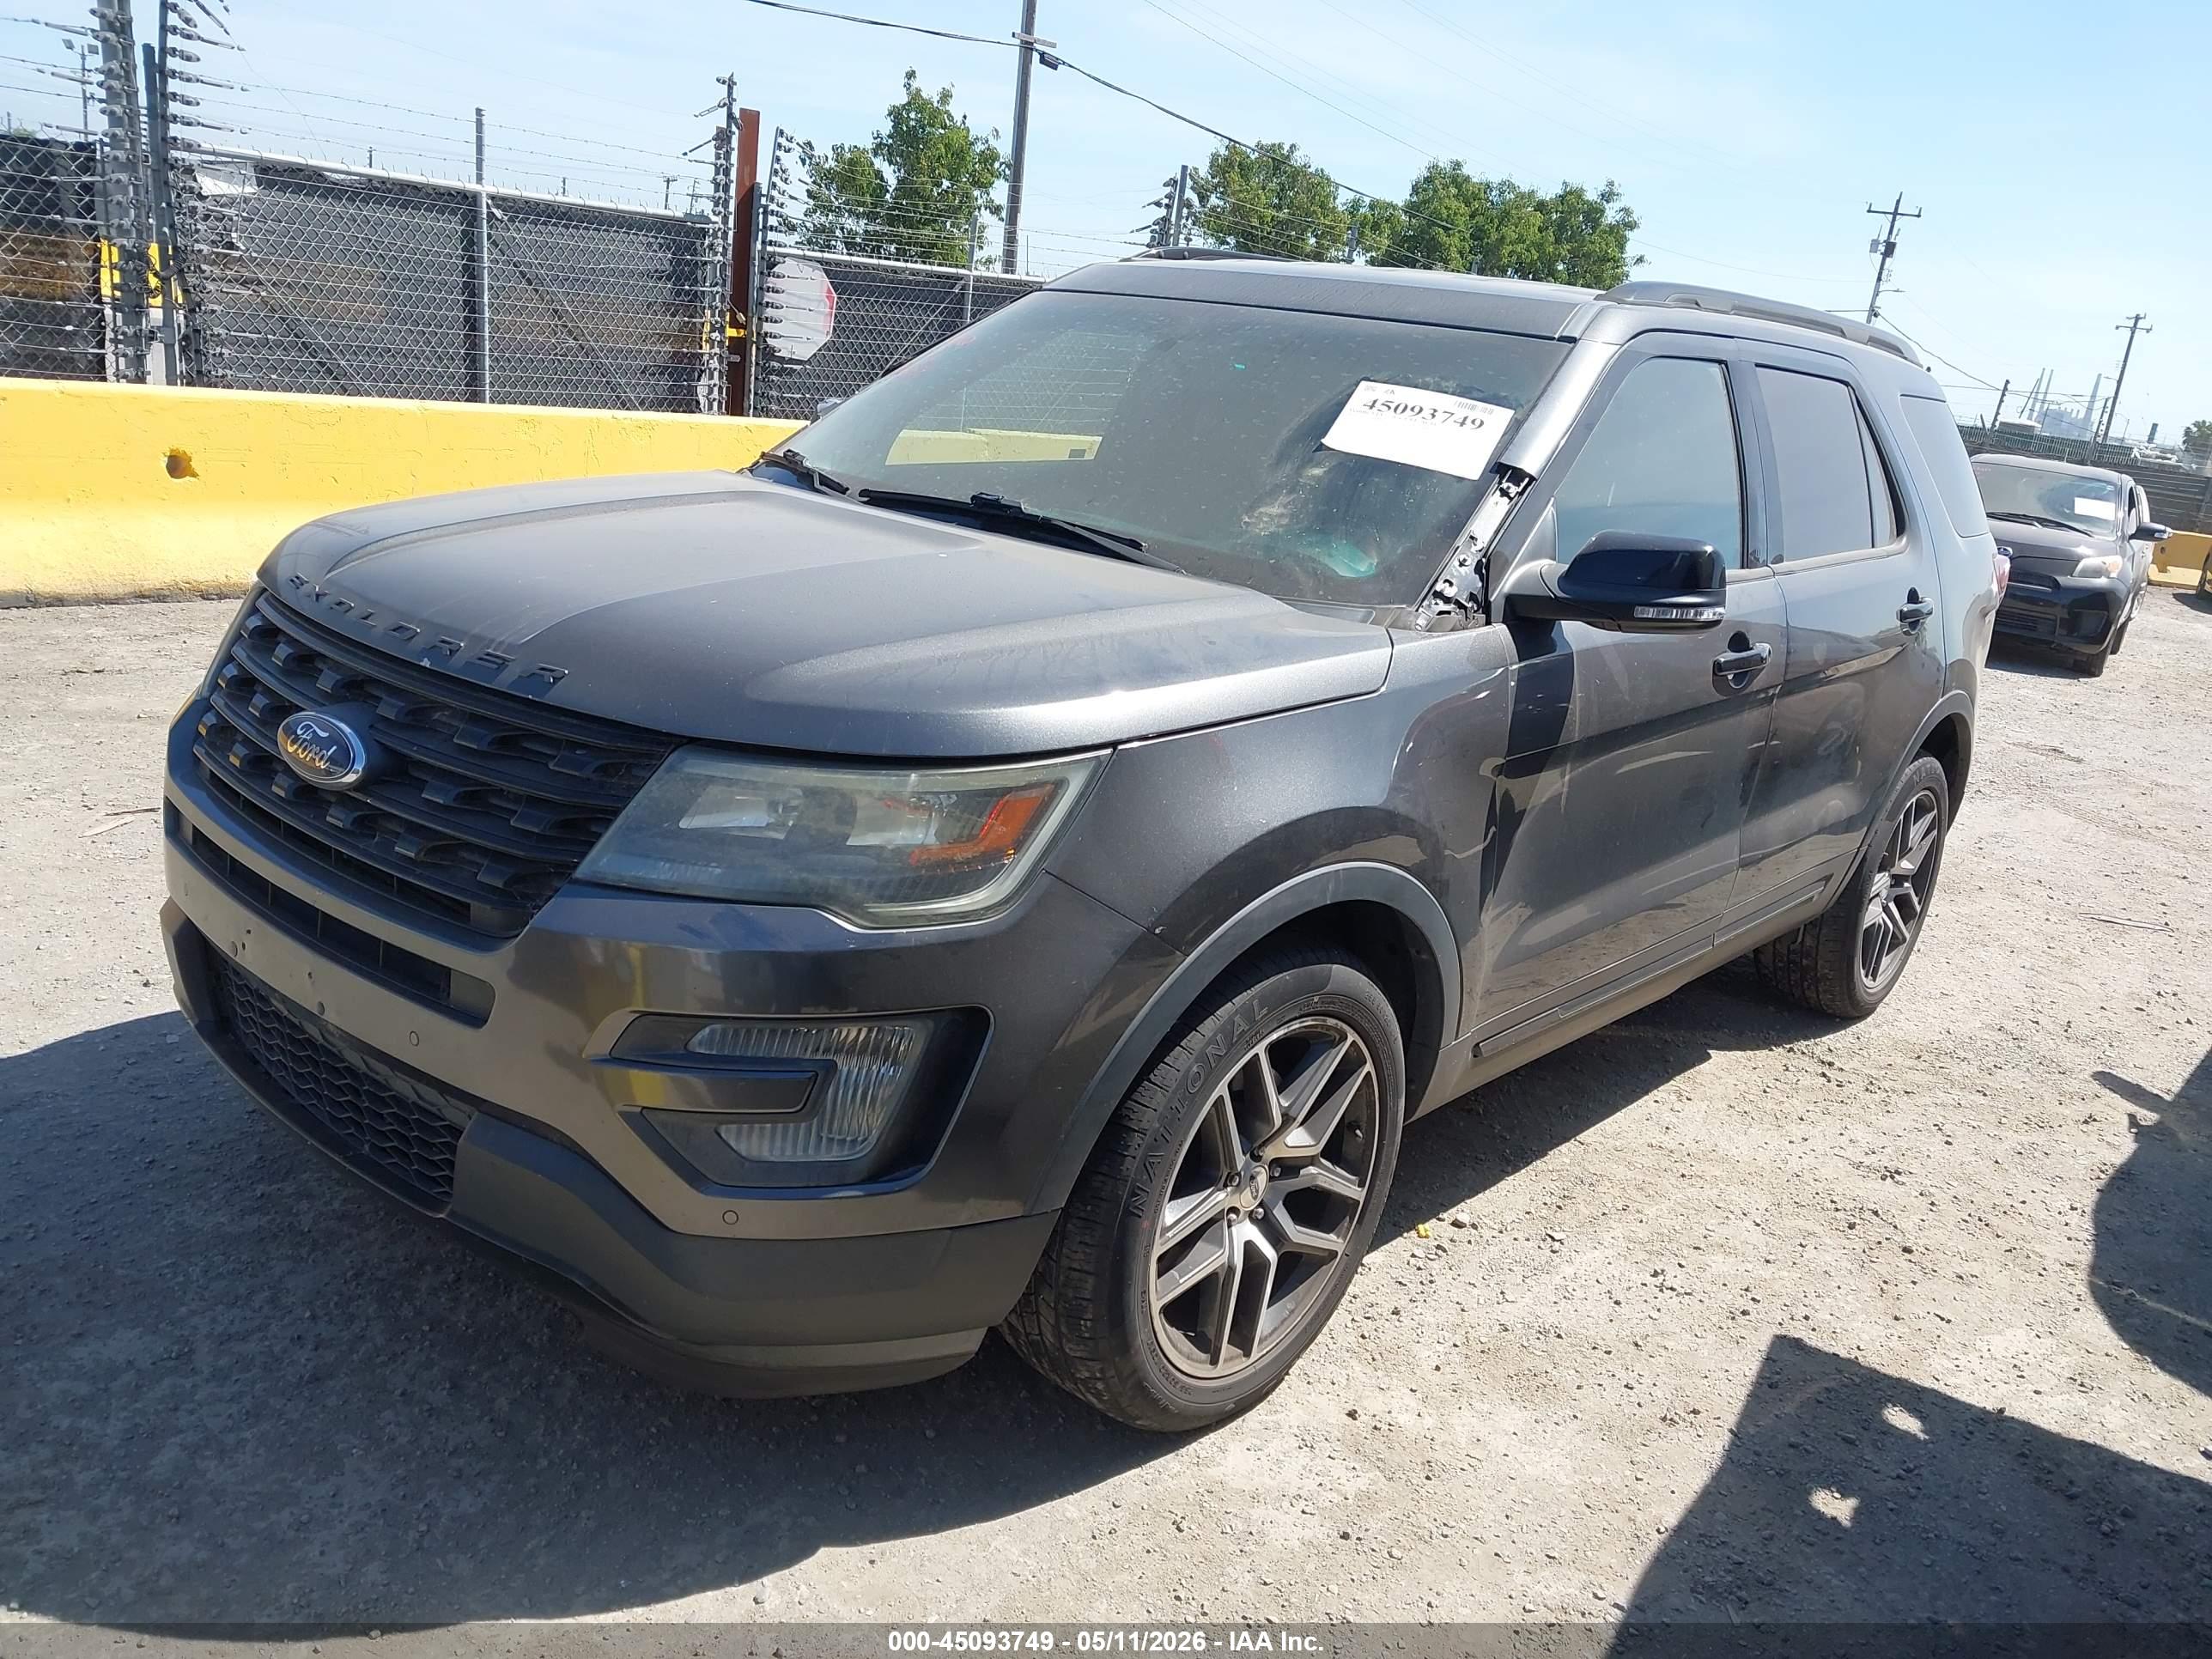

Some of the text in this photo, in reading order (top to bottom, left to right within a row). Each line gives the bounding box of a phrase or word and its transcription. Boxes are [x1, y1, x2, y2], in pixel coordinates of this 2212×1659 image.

[1362, 398, 1485, 430] 45093749
[287, 721, 337, 769] Ford
[1128, 1000, 1270, 1219] NATIONAL
